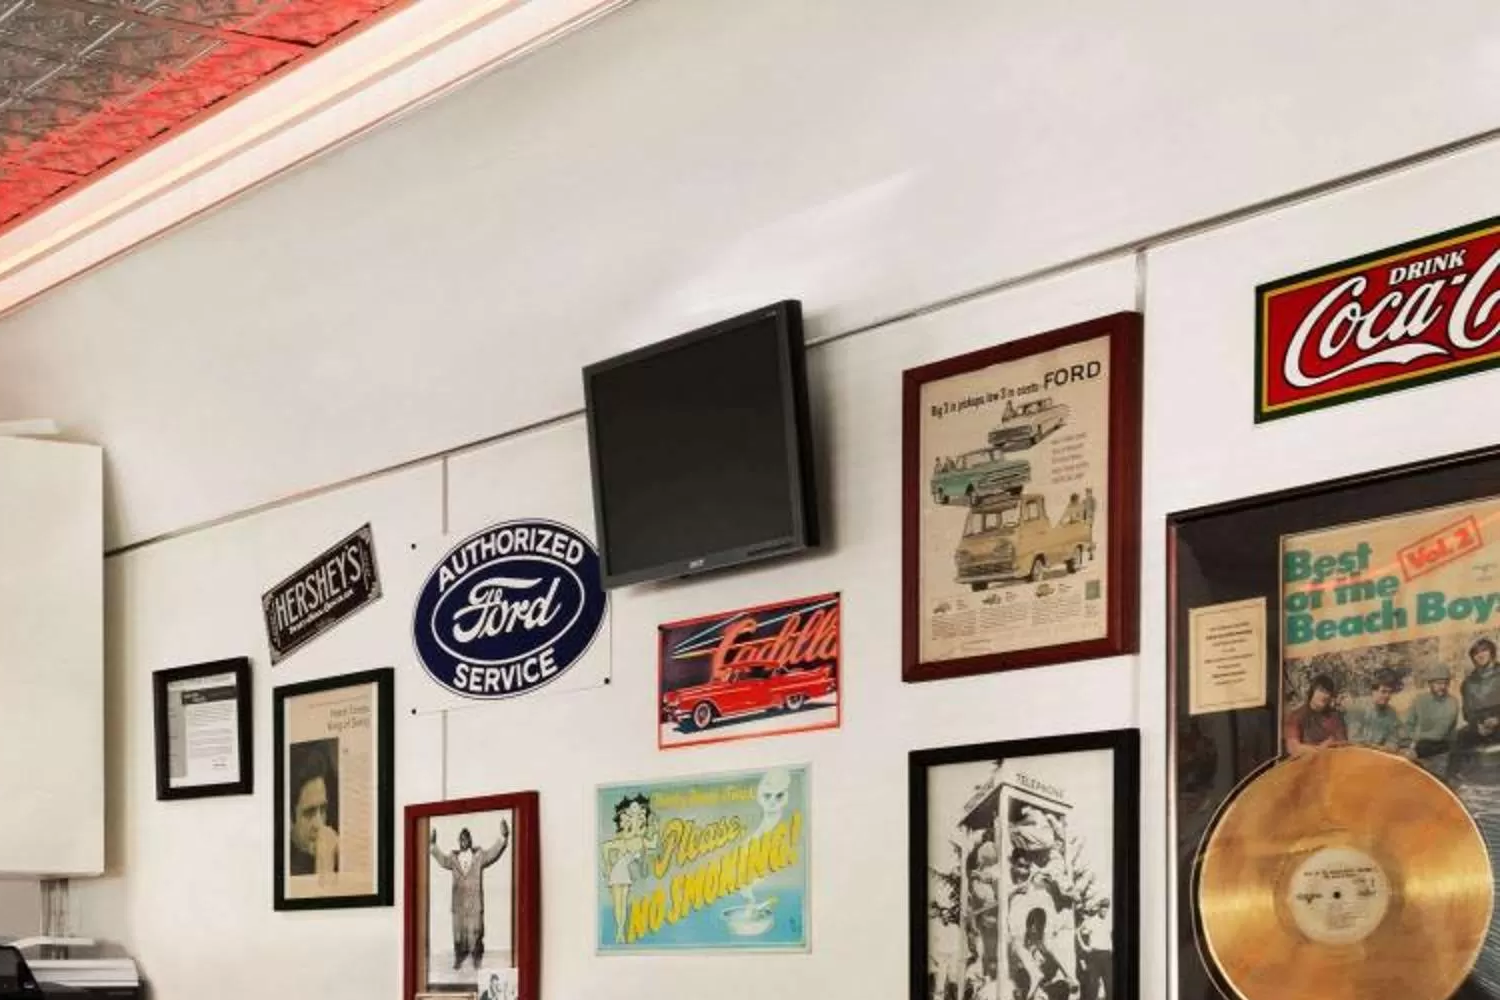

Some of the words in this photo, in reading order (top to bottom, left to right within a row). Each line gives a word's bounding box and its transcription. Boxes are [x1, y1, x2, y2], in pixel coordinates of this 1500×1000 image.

[1388, 249, 1467, 285] DRINK
[1043, 361, 1102, 390] FORD
[437, 527, 584, 593] AUTHORIZED
[1284, 541, 1373, 582] Best
[1406, 539, 1454, 569] Vol.
[1454, 527, 1475, 548] 2
[275, 544, 362, 632] HERSHEY'S
[452, 577, 562, 643] Ford
[1286, 599, 1408, 645] Beach
[453, 648, 559, 693] SERVICE
